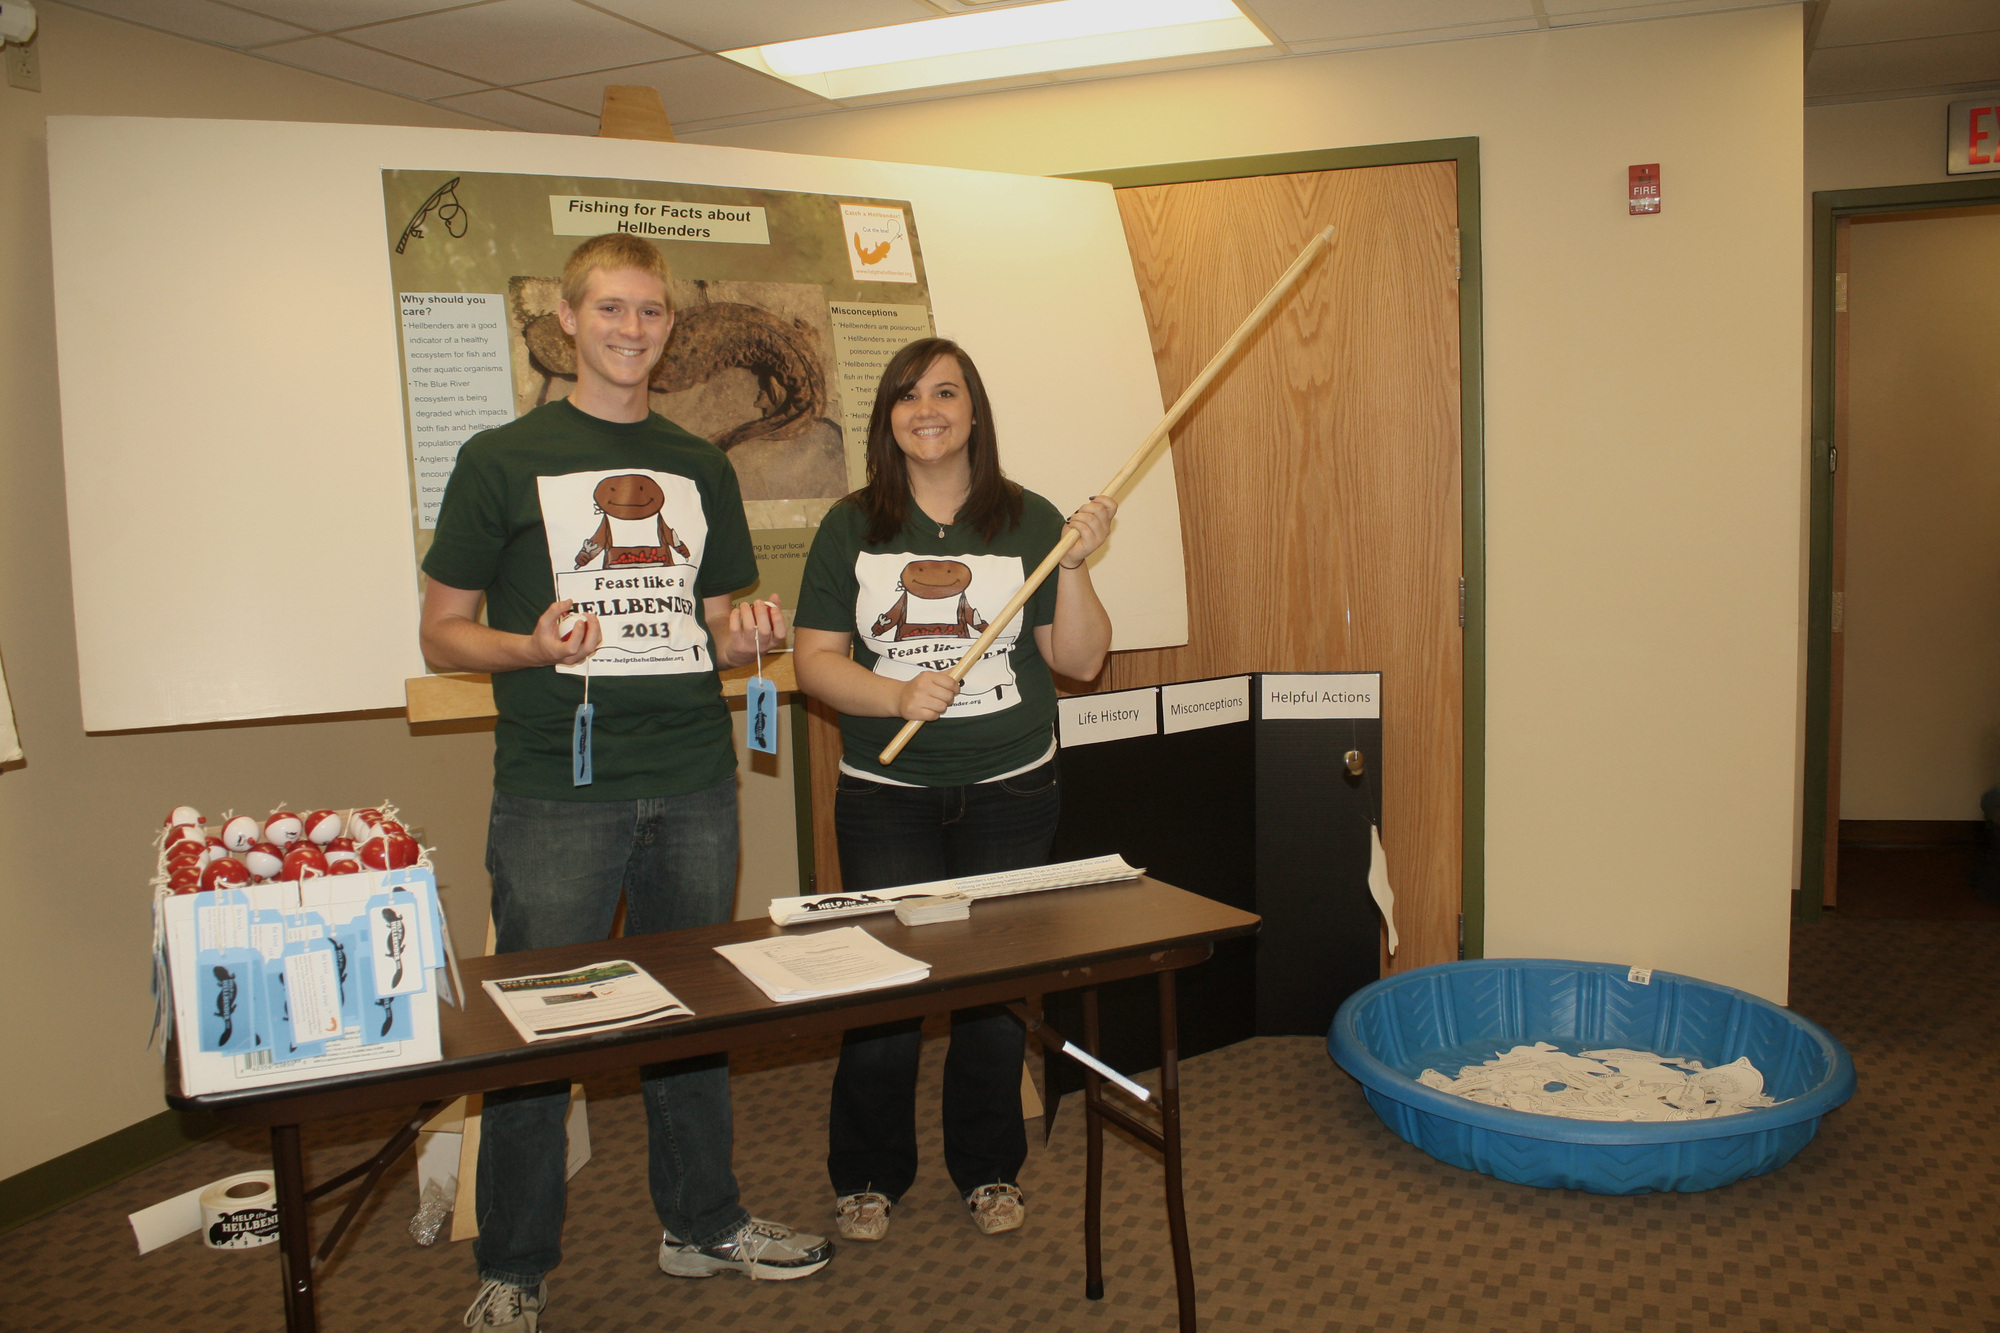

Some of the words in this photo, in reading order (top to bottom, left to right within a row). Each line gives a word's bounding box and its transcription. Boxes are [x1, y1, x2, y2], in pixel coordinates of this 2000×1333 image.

[1633, 186, 1656, 195] FIRE
[568, 200, 629, 217] Fishing
[634, 203, 656, 215] for
[661, 205, 703, 219] Facts
[708, 209, 751, 222] about
[617, 220, 711, 238] Hellbenders
[401, 295, 425, 305] Why
[428, 295, 464, 304] should
[466, 297, 486, 306] you
[403, 307, 432, 316] care?
[831, 307, 898, 317] Misconceptions
[478, 322, 497, 330] good
[838, 322, 877, 330] "Hellbenders
[461, 336, 488, 345] healthy
[848, 335, 884, 343] Hellbenders
[434, 366, 462, 374] aquatic
[464, 365, 503, 374] organisms
[414, 395, 456, 403] ecosystem
[466, 394, 488, 402] being
[416, 410, 452, 418] degraded
[478, 409, 508, 417] impacts
[419, 456, 449, 464] Anglers
[772, 544, 787, 552] your
[595, 577, 640, 591] Feast
[643, 576, 674, 588] like
[679, 578, 684, 587] a
[621, 622, 670, 638] 2013
[887, 645, 929, 659] Feast
[933, 644, 962, 653] li
[1271, 691, 1318, 705] Helpful
[1322, 691, 1371, 703] Actions
[1170, 697, 1243, 716] Misconceptions
[1078, 713, 1098, 725] Life
[1101, 708, 1140, 723] History
[817, 901, 843, 910] HELP
[232, 1213, 255, 1222] HELP
[222, 1214, 278, 1232] HELLBEN
